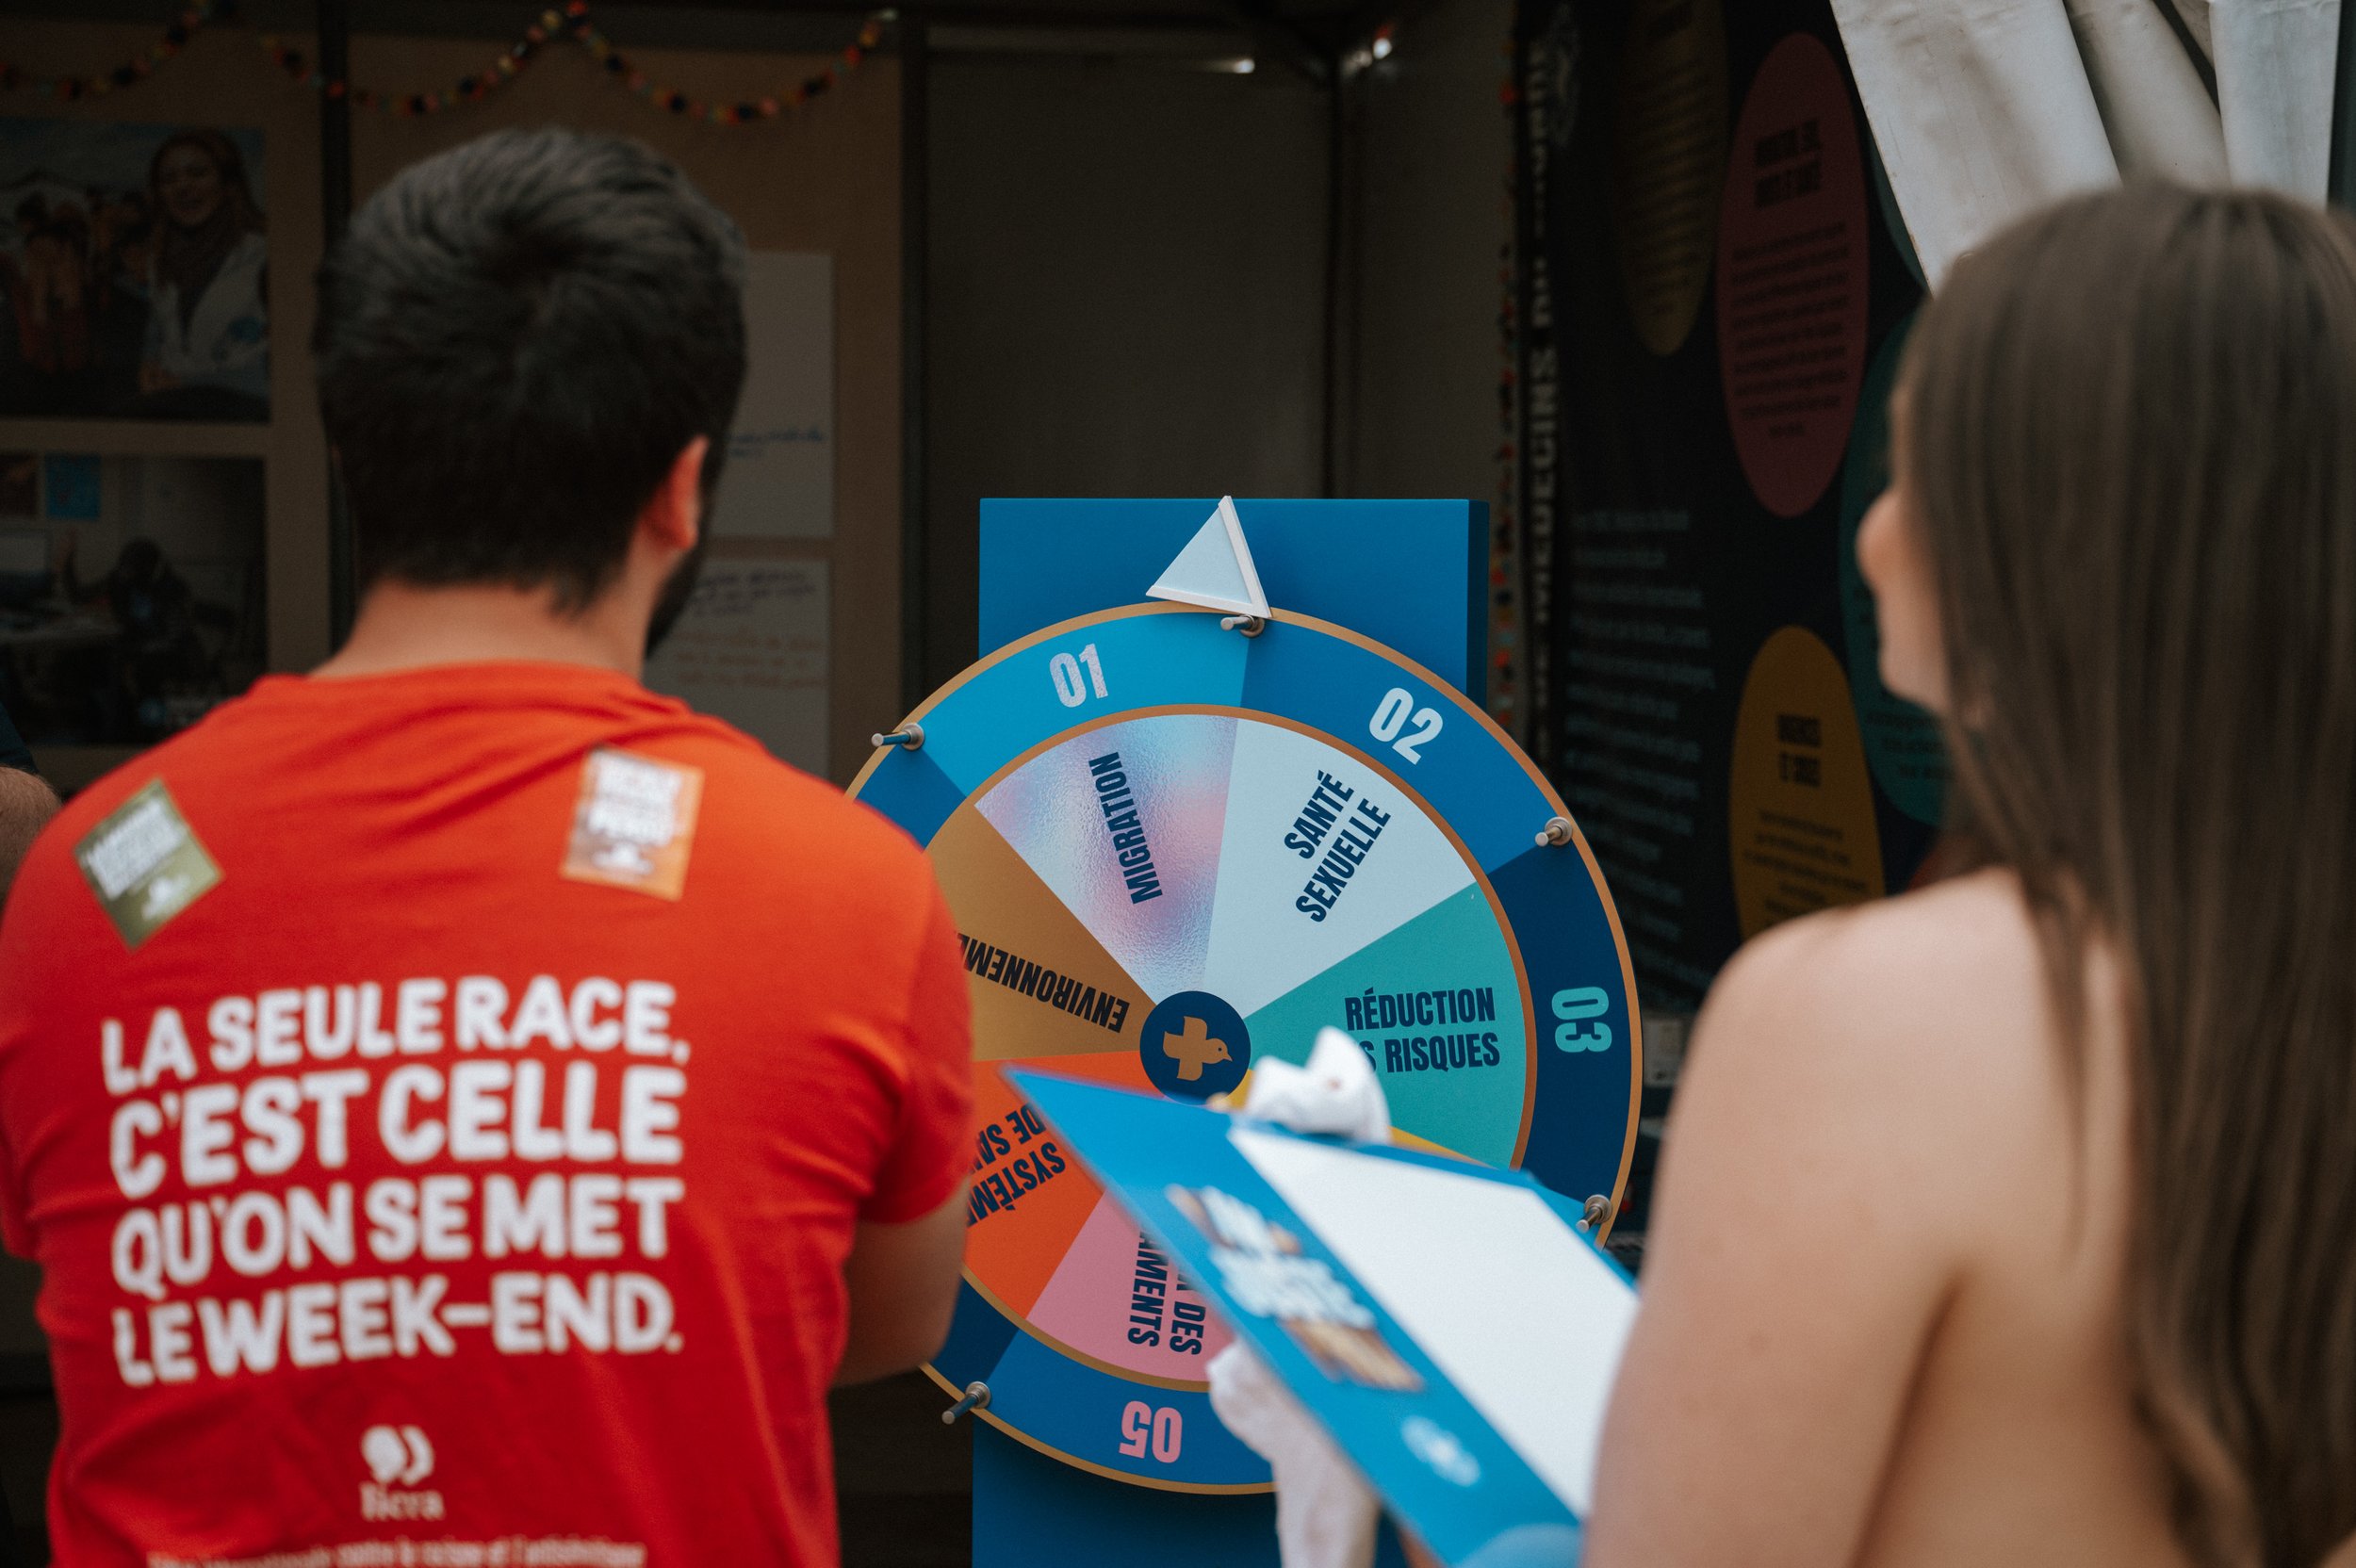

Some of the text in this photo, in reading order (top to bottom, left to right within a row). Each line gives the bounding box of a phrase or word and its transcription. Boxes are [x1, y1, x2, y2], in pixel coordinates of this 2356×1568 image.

[1049, 644, 1109, 708] 01
[1369, 687, 1444, 765] 02
[1088, 752, 1163, 906] MIGRATION
[1284, 770, 1355, 859] SANTÉ
[1295, 798, 1391, 923] SEXUELLE
[101, 1007, 196, 1095] LA
[207, 978, 447, 1071] SEULE
[1344, 987, 1496, 1031] RÉDUCTION
[1551, 987, 1612, 1054] 03
[1384, 1032, 1500, 1073] RISQUES
[110, 1060, 687, 1198] C'EST CELLE
[1006, 1102, 1046, 1144] DE
[112, 1174, 685, 1299] QU'ON SE MET
[112, 1303, 197, 1386] LE
[1170, 1301, 1206, 1355] DES
[1119, 1400, 1183, 1463] 05
